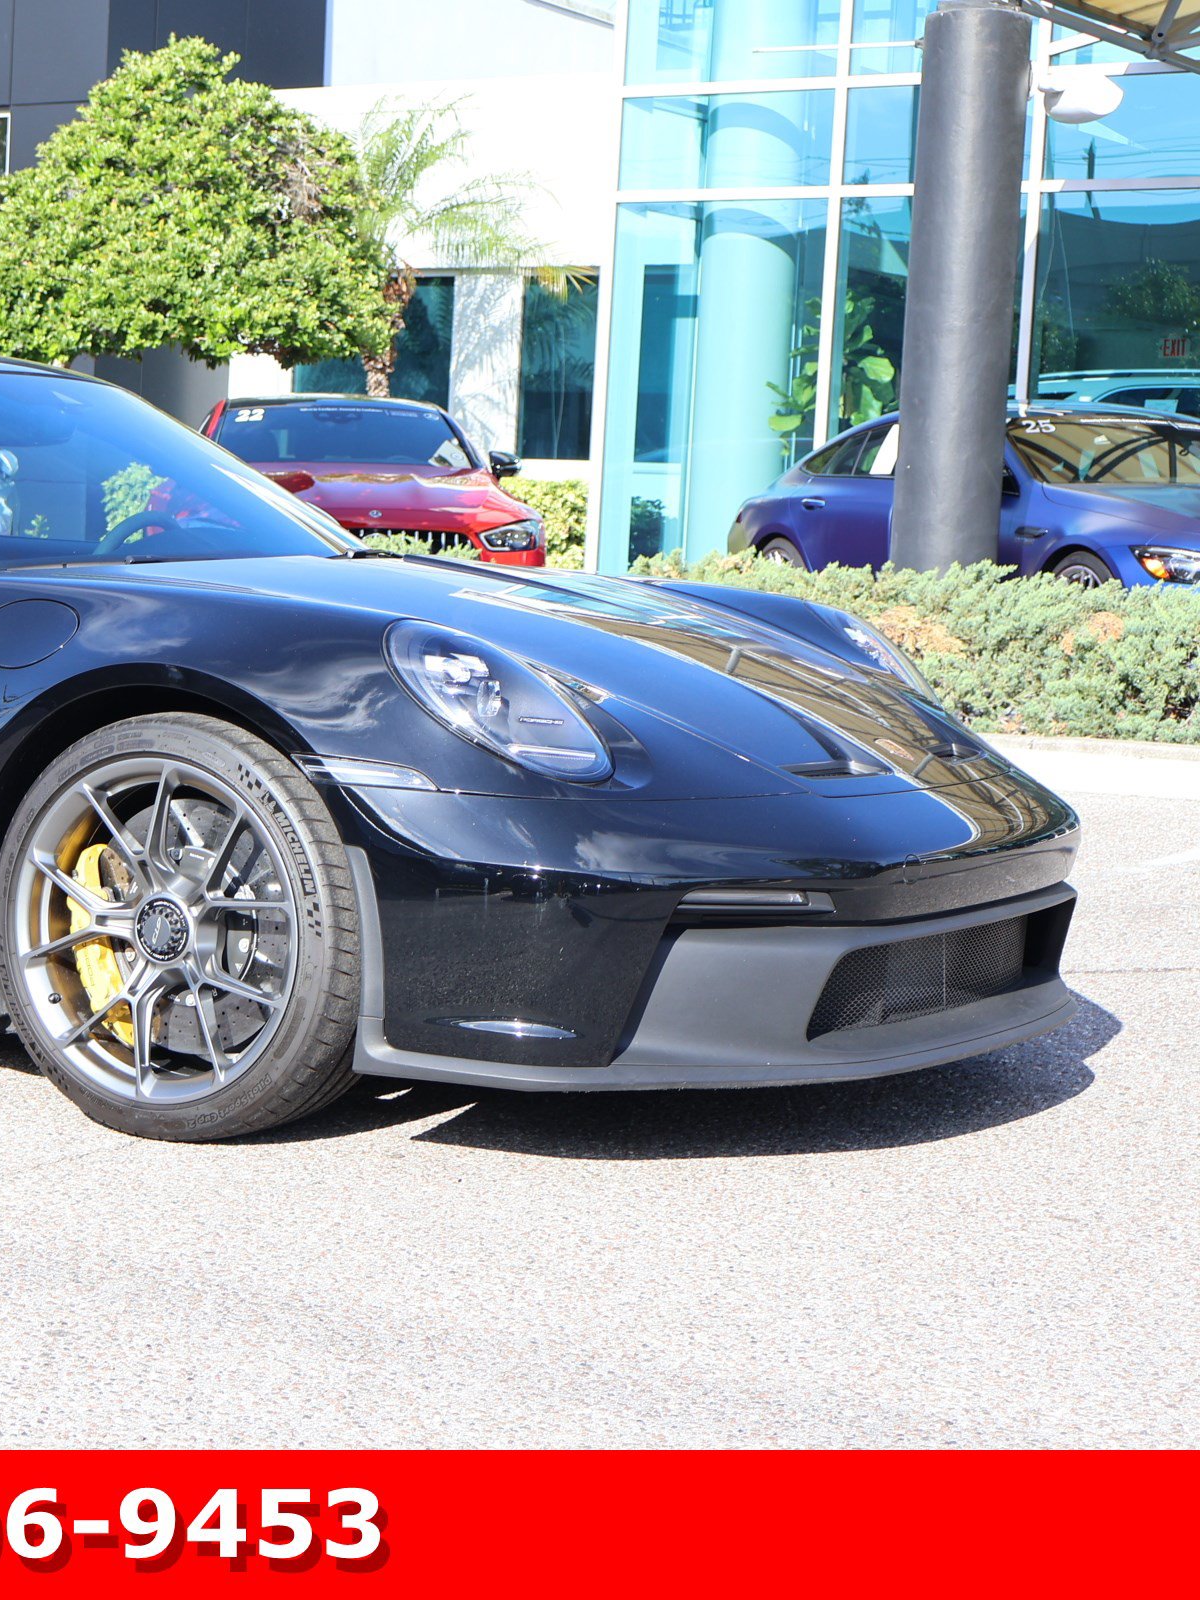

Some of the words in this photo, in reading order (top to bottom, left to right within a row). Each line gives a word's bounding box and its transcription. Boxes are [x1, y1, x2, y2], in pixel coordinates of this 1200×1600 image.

[1163, 338, 1186, 357] EXIT
[234, 408, 265, 422] 22
[1022, 419, 1056, 434] 25
[519, 716, 564, 725] PORSCHE
[273, 810, 317, 895] MICHELIN
[247, 1073, 272, 1099] Pilot
[218, 1092, 249, 1119] Sport
[187, 1119, 197, 1129] 2
[195, 1111, 218, 1126] Cup
